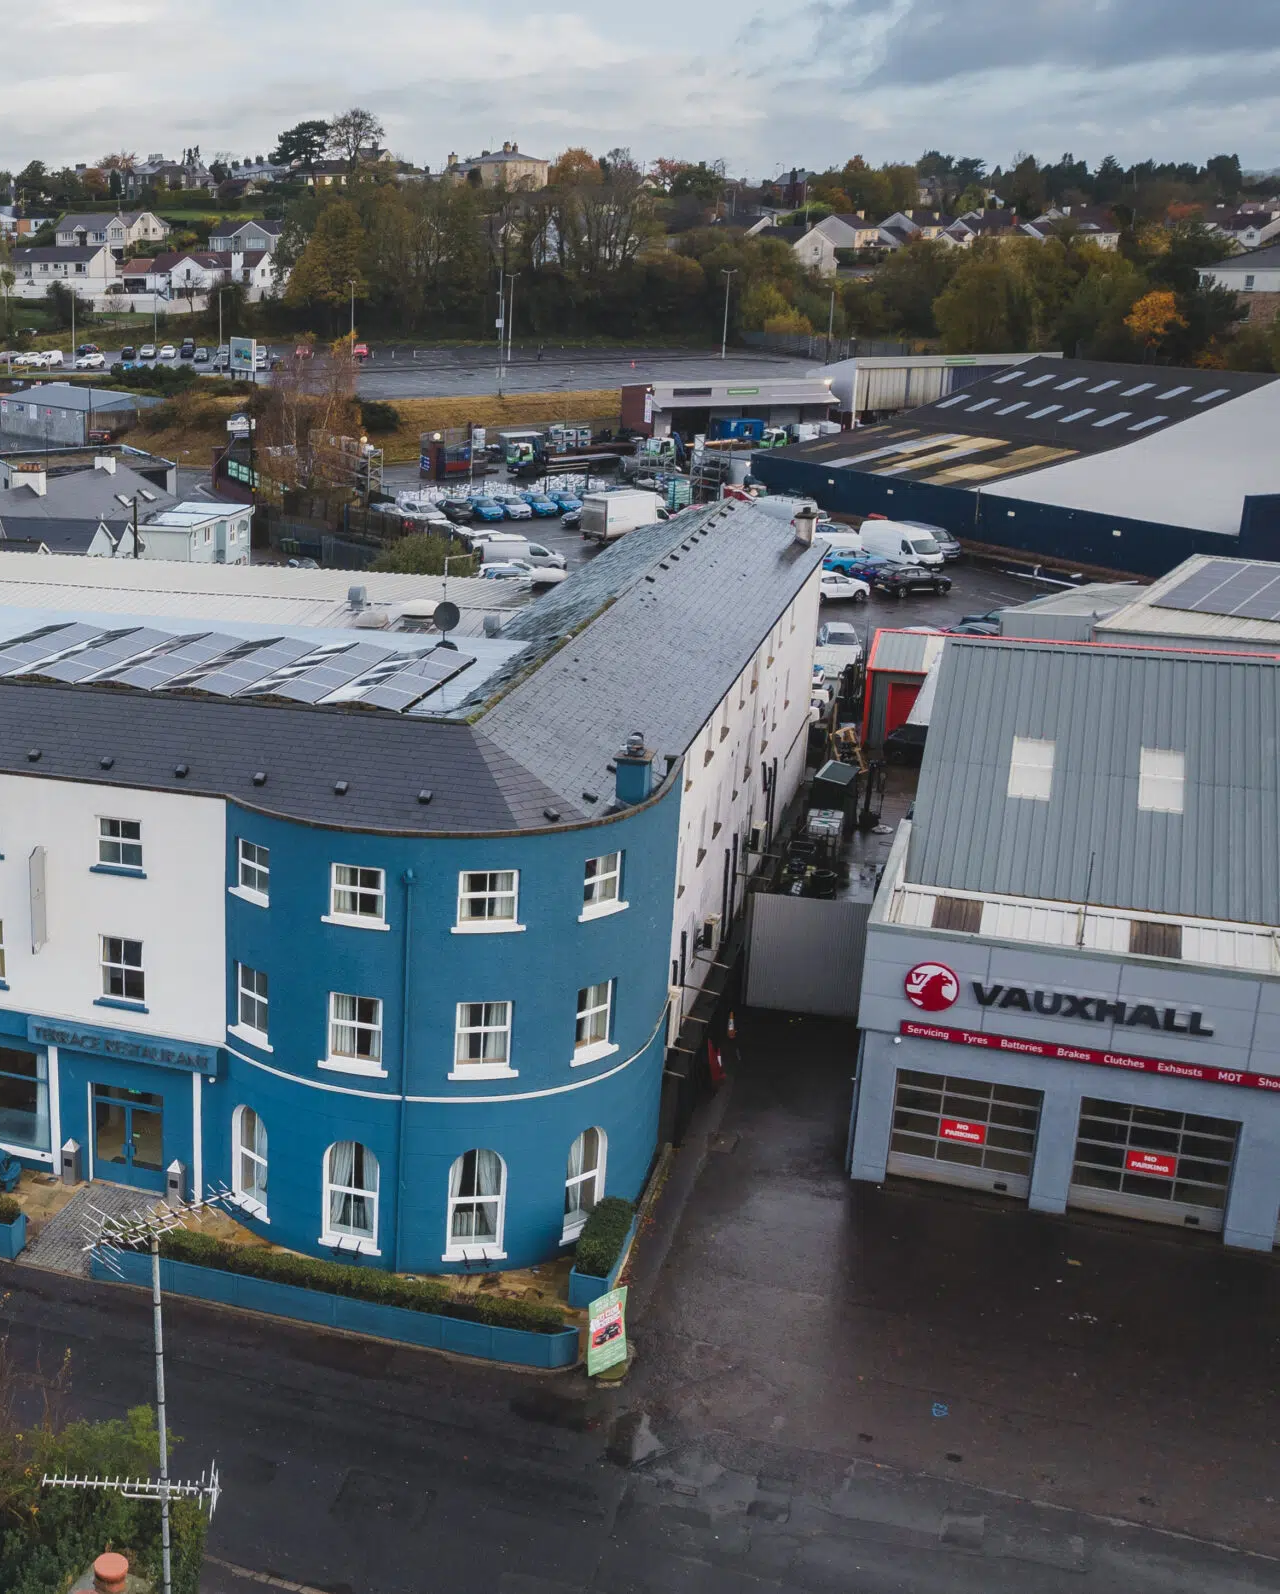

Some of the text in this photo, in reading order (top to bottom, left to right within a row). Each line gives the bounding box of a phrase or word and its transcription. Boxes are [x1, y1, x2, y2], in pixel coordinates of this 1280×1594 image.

[972, 980, 1214, 1037] VAUXHALL
[33, 1025, 210, 1068] TERRACE RESTAURANT
[907, 1025, 949, 1040] Servicing
[963, 1033, 988, 1045] Tyres
[1000, 1039, 1043, 1053] Batteries
[1057, 1048, 1091, 1060] Brakes
[1104, 1055, 1145, 1069] Clutches
[1157, 1062, 1203, 1078] Exhausts
[1218, 1071, 1243, 1083] MOT
[956, 1123, 969, 1131] NO
[944, 1128, 980, 1141] PARKING
[1143, 1155, 1158, 1163] NO
[1131, 1161, 1169, 1173] PARKING
